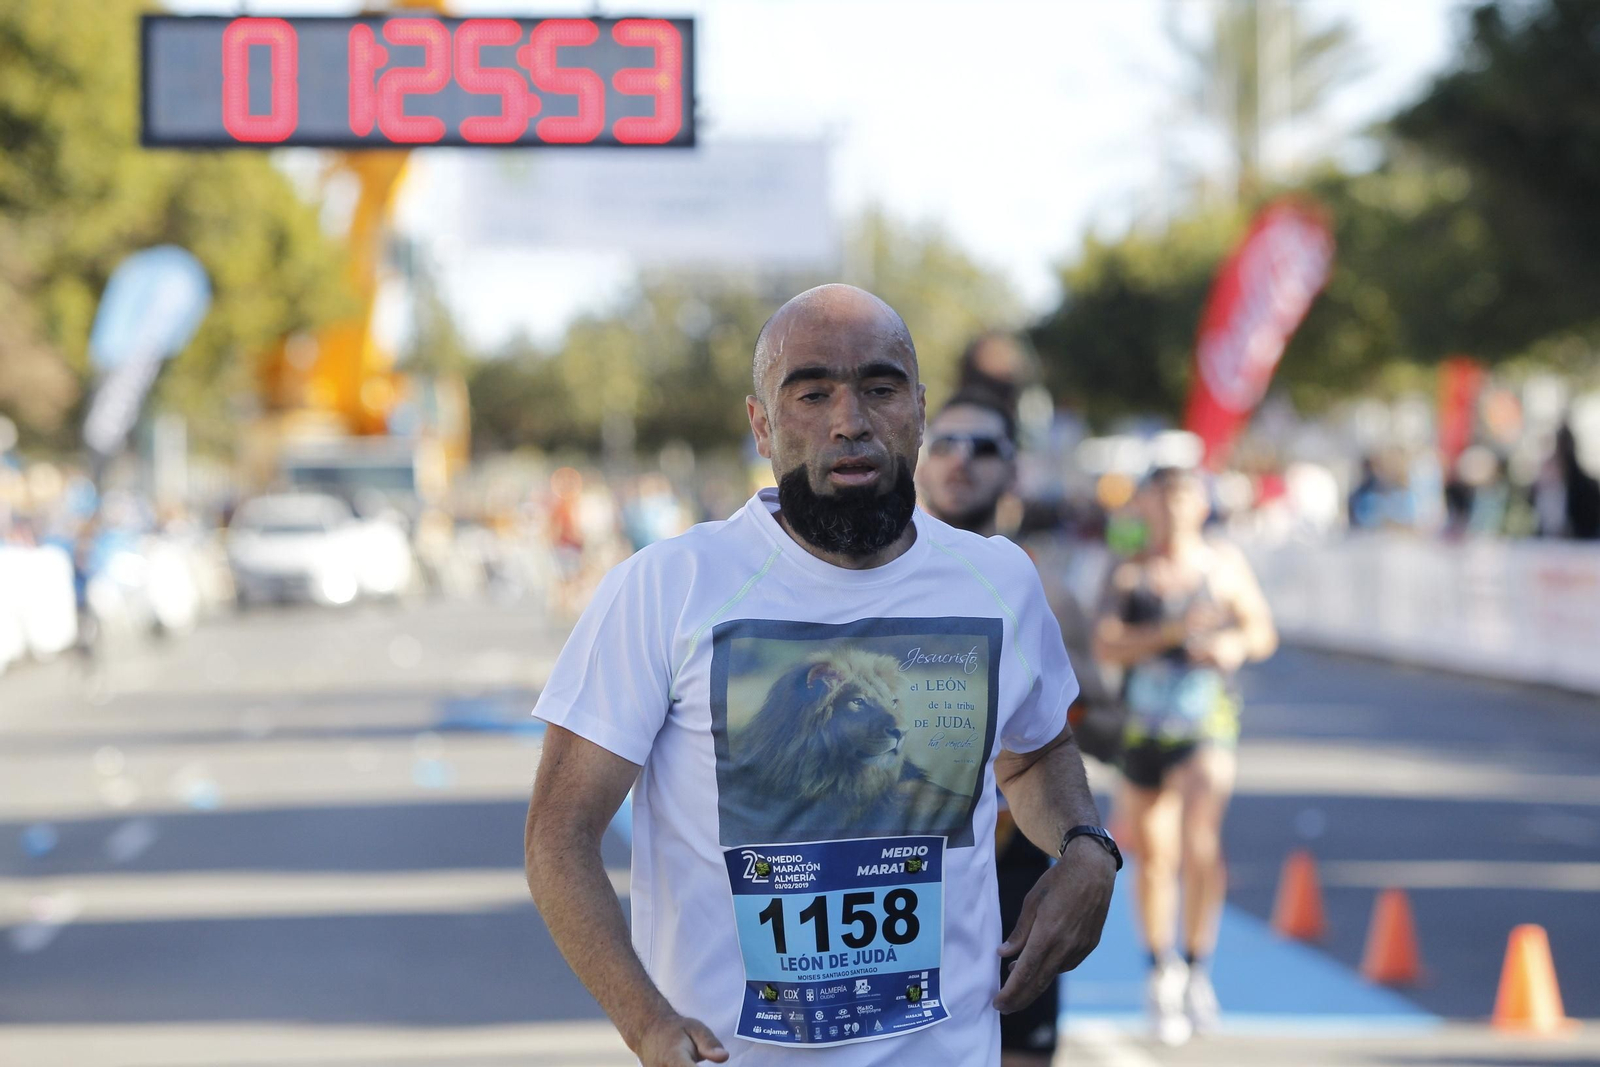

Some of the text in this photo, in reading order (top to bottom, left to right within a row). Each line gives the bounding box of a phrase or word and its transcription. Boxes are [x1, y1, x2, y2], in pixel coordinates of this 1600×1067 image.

[898, 645, 978, 674] Jesucristo
[910, 676, 967, 691] el LEÓN
[928, 701, 975, 711] de la tribu
[914, 716, 976, 731] DE JUDA,
[881, 845, 929, 859] MEDIO
[772, 855, 803, 864] MEDIO
[773, 861, 821, 873] MARATÓN
[856, 860, 929, 876] MARATN
[774, 872, 816, 883] ALMERÍA
[758, 888, 920, 954] 1158
[780, 945, 898, 972] LEÓN DE JUDÁ
[821, 970, 850, 979] SANTIAGO
[850, 967, 878, 977] SANTIAGO
[820, 985, 848, 995] ALMERÍA
[755, 1012, 783, 1021] Blanes
[762, 1027, 789, 1036] cajamar
